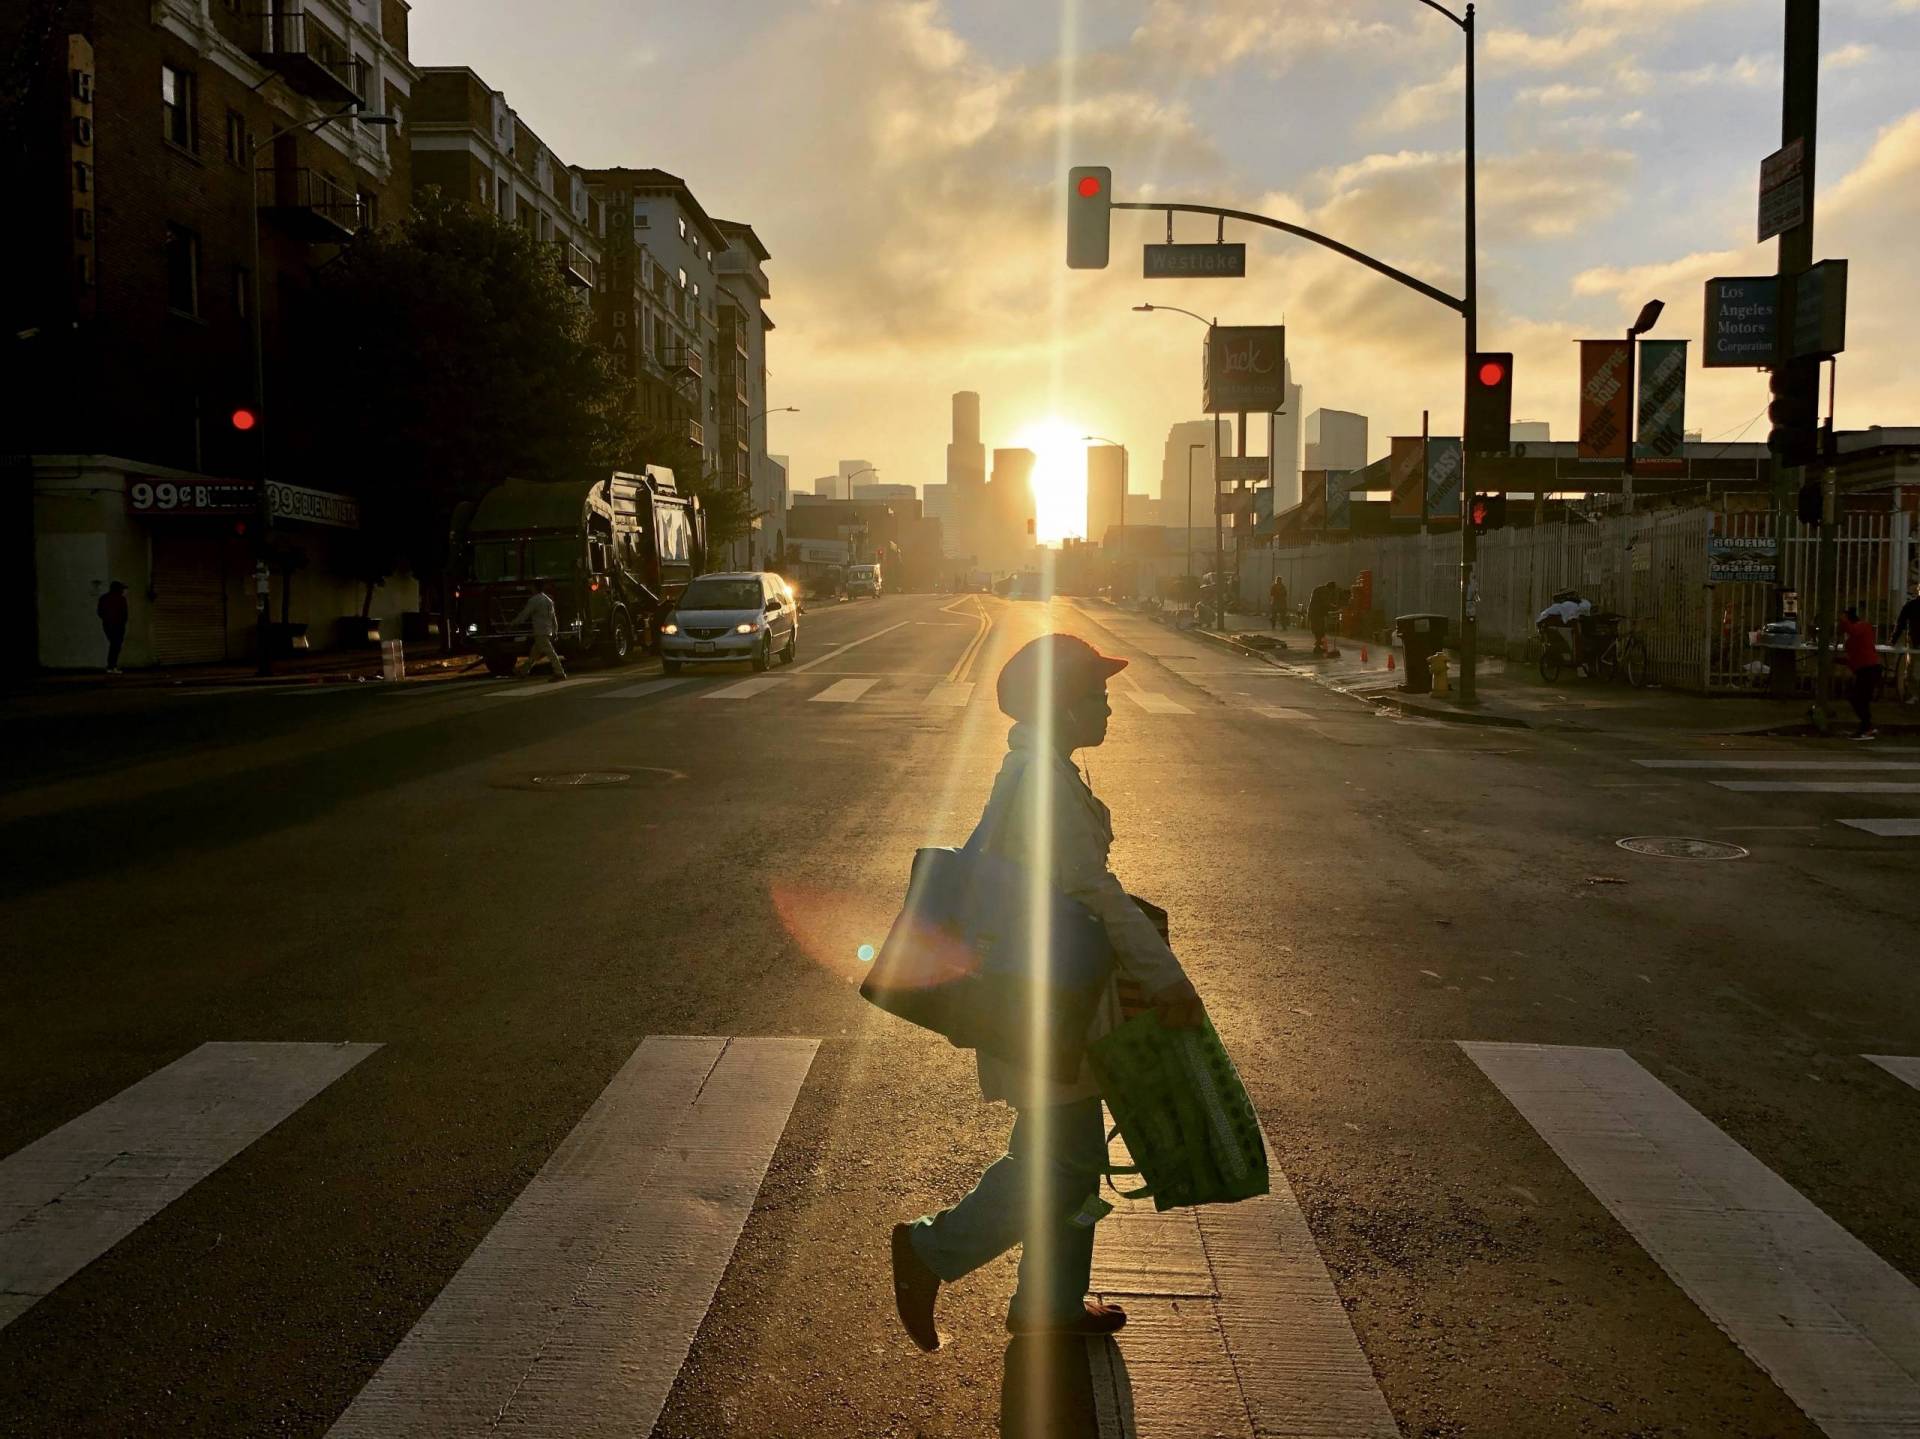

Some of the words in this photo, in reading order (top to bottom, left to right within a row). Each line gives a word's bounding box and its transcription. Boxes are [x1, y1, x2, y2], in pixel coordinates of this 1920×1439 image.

[72, 68, 95, 287] HOTEL
[610, 189, 628, 293] HOTEL
[1152, 252, 1239, 270] Westlake
[1720, 285, 1745, 299] Los
[1719, 303, 1774, 321] Angeles
[611, 310, 628, 371] BAR
[1718, 320, 1766, 335] Motors
[1219, 339, 1275, 374] Jack
[1717, 338, 1774, 354] Corporation
[1592, 376, 1621, 407] AQUI
[1652, 424, 1682, 456] OK
[1428, 445, 1461, 486] EASY
[131, 483, 192, 509] 99¢
[302, 493, 332, 519] BUENA
[1713, 538, 1777, 548] ROOFING
